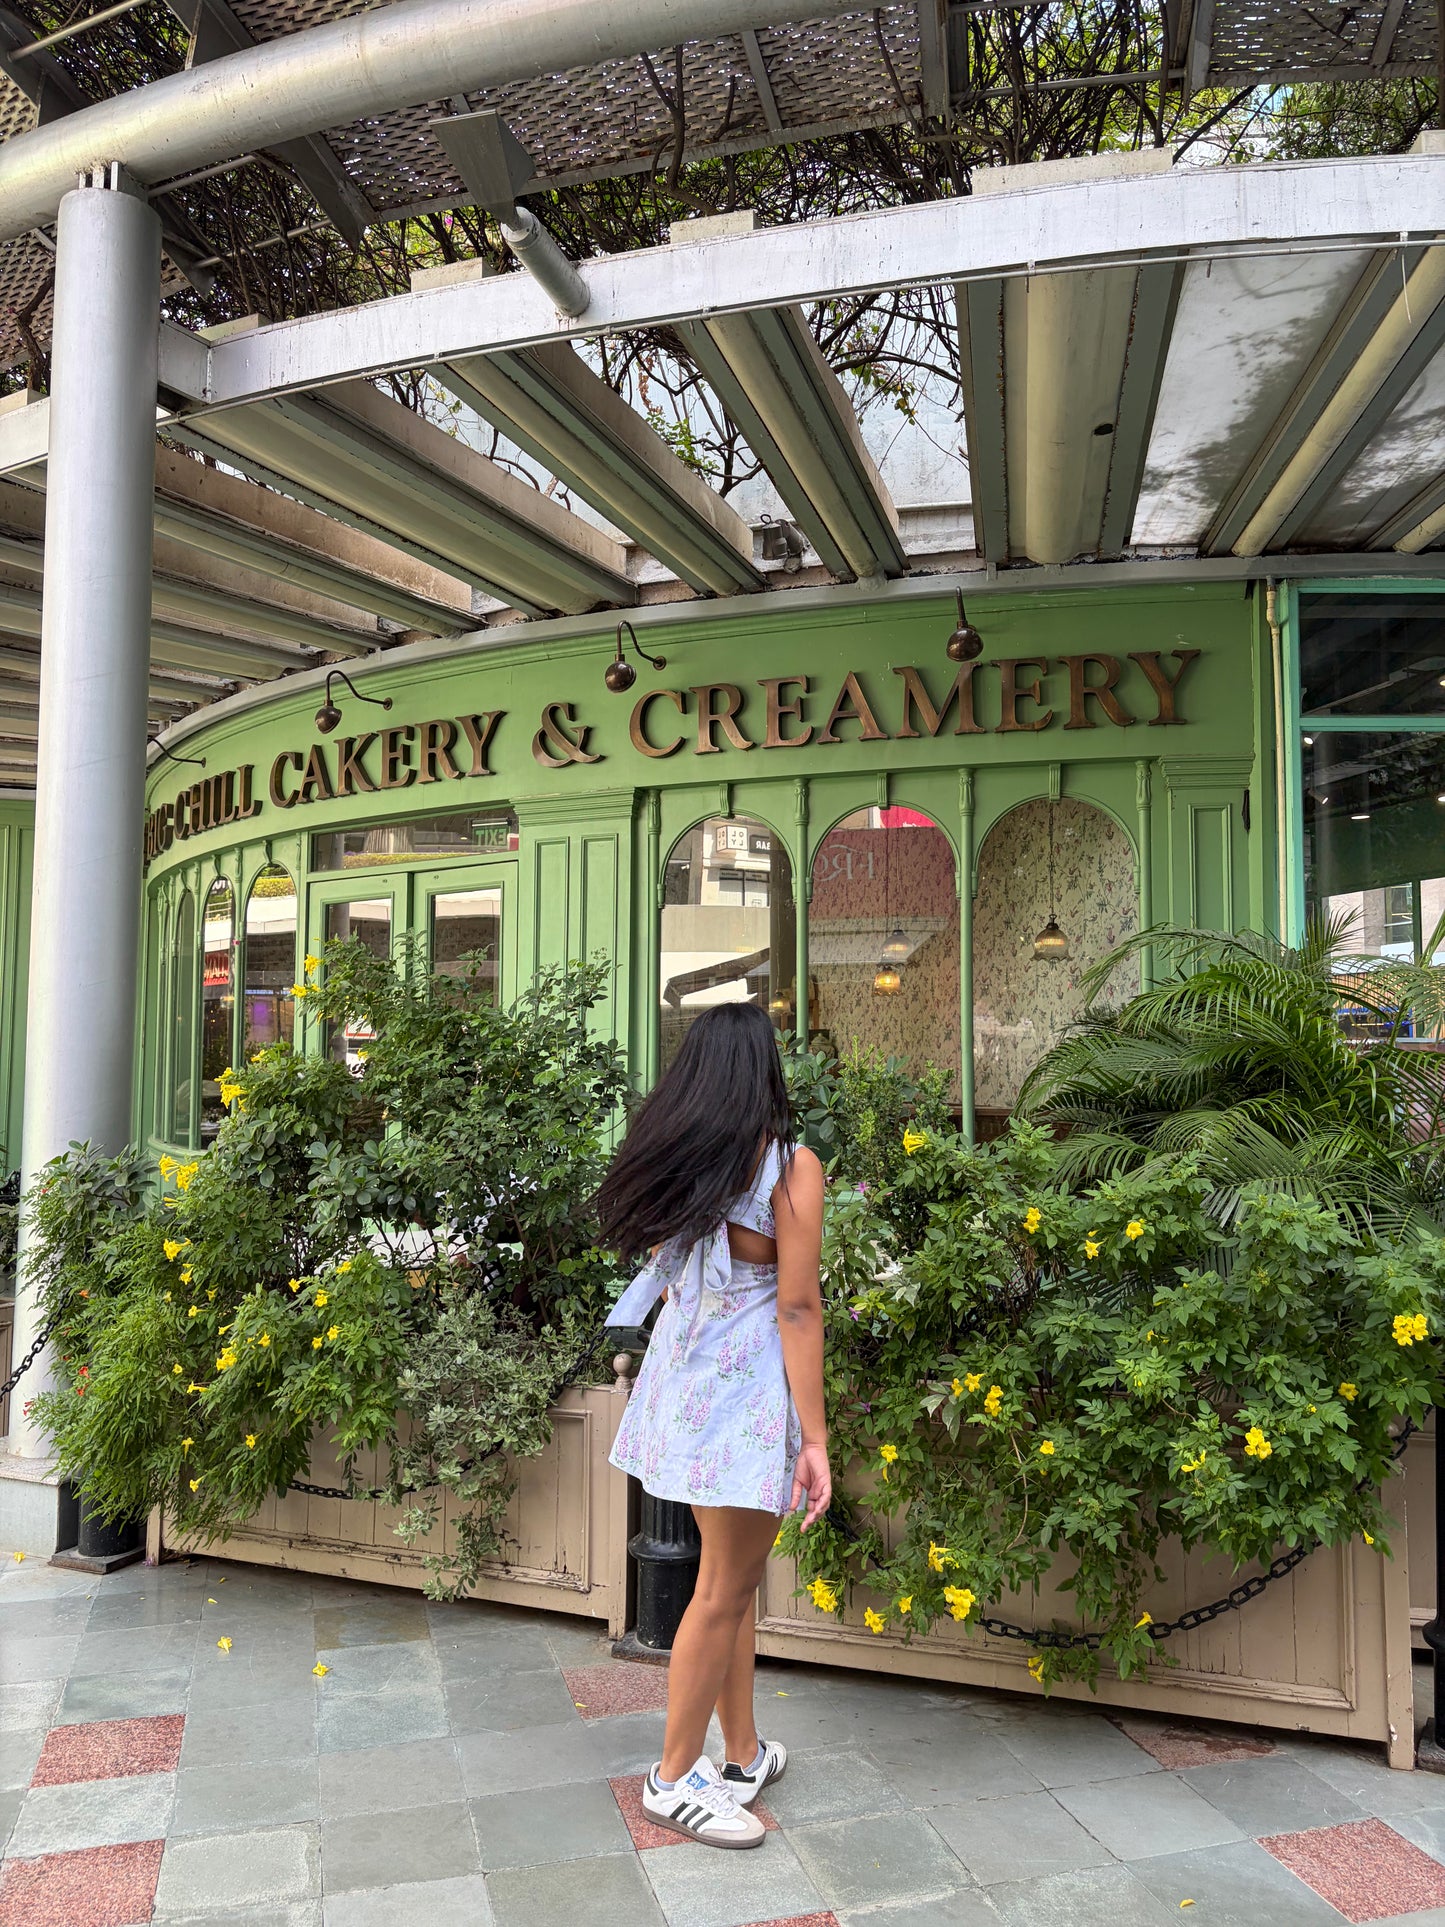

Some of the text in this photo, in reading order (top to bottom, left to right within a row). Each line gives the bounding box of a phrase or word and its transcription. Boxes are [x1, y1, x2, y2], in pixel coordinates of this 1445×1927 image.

[174, 764, 263, 840] CHILL
[269, 710, 507, 808] CAKERY
[531, 703, 606, 768] &
[629, 649, 1201, 759] CREAMERY
